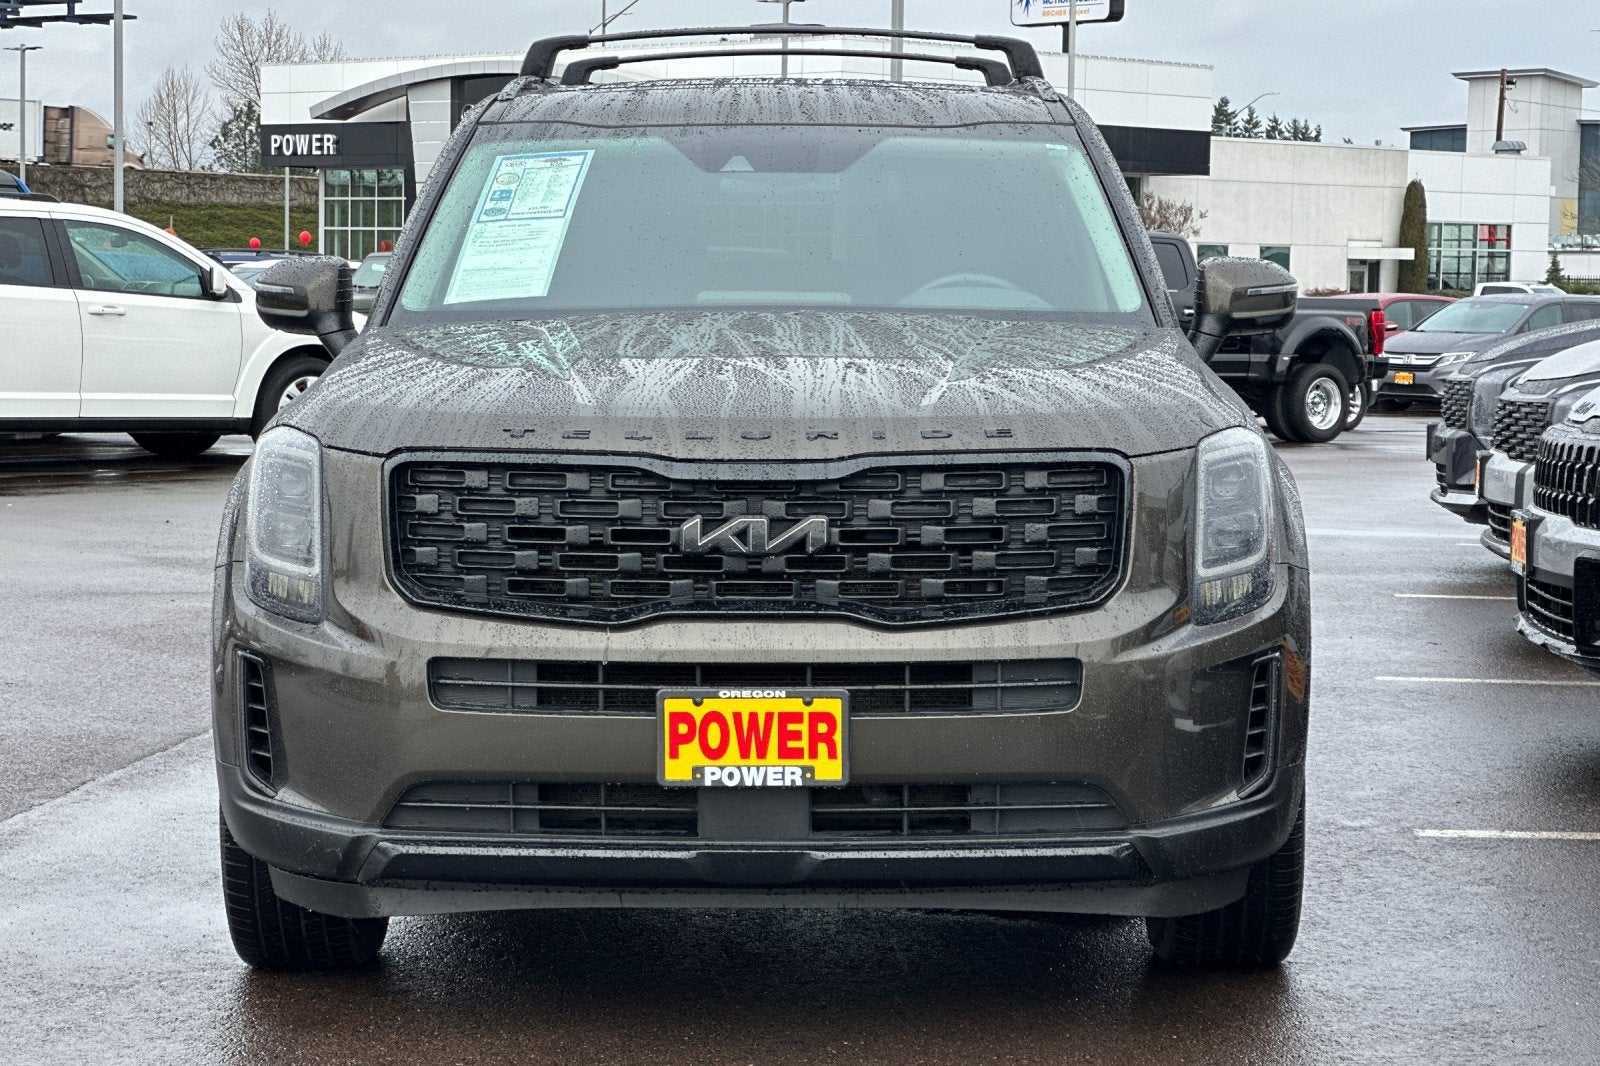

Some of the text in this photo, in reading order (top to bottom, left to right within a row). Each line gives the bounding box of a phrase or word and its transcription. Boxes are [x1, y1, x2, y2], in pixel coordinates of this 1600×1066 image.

[271, 134, 337, 156] POWER
[502, 428, 1014, 441] TELLURIDE
[680, 514, 829, 555] KIA
[718, 690, 786, 698] OREGON
[669, 711, 838, 761] POWER
[704, 766, 803, 786] POWER
